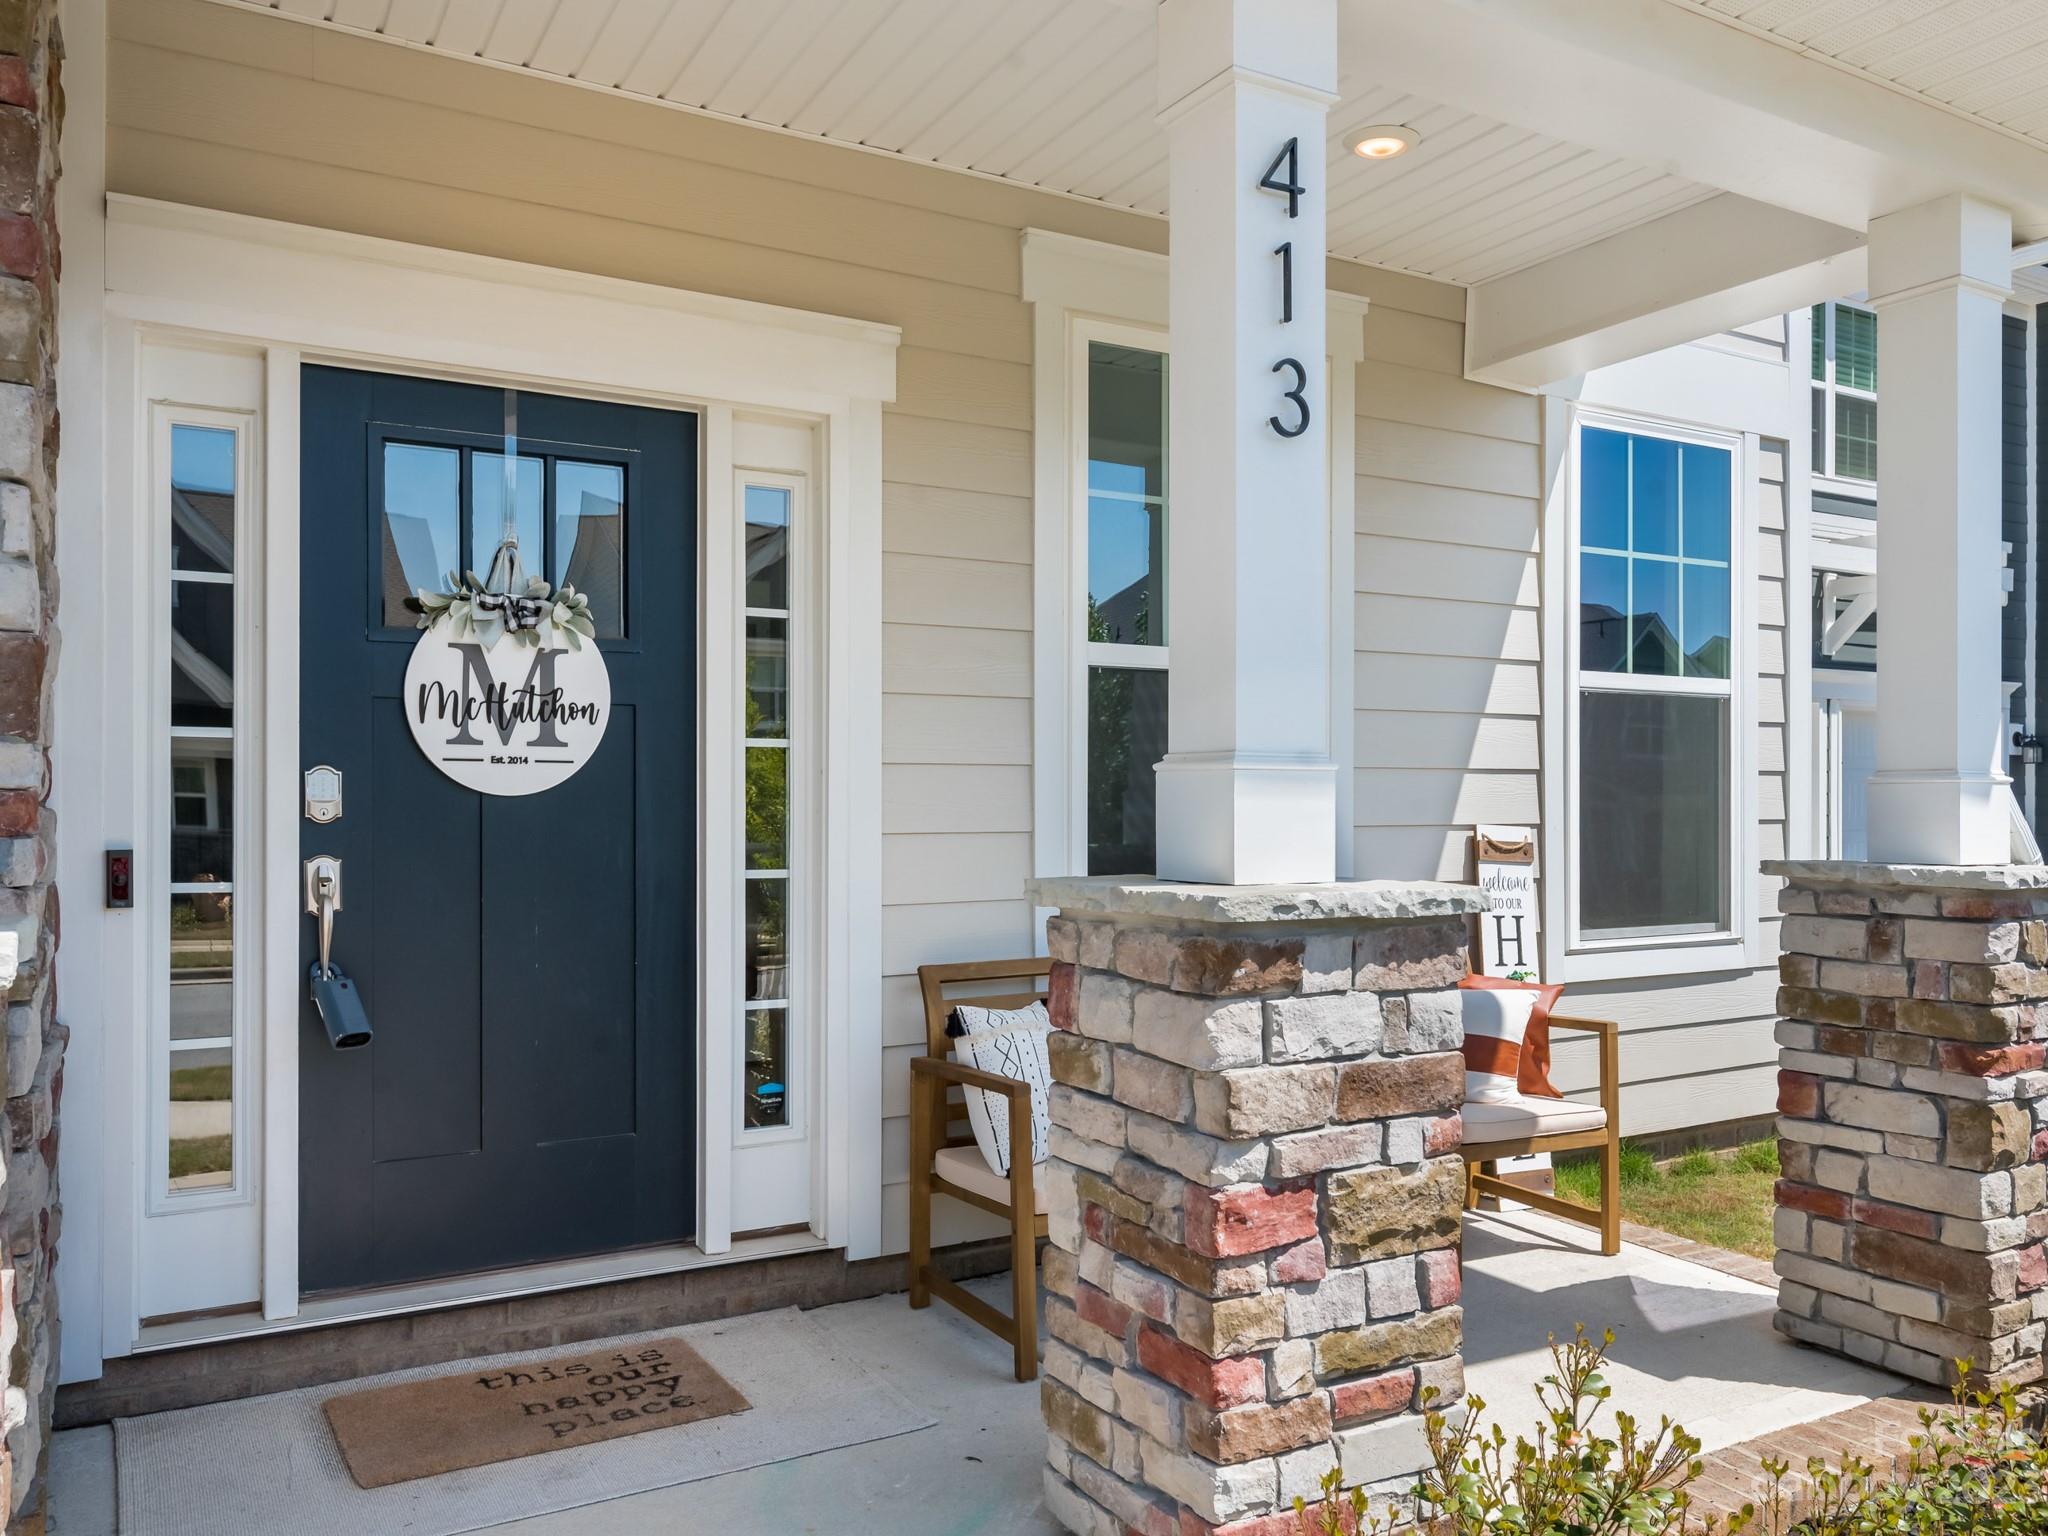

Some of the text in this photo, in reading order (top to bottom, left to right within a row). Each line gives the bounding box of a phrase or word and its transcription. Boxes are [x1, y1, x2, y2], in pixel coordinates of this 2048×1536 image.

[1259, 136, 1310, 438] 413
[419, 680, 600, 730] McHutchon
[446, 642, 569, 748] M
[490, 755, 529, 765] Est. 2014
[1482, 867, 1530, 892] welcome
[1493, 898, 1522, 910] TO OUR
[476, 1348, 665, 1391] this is
[586, 1360, 673, 1386] our
[520, 1374, 684, 1416] happy
